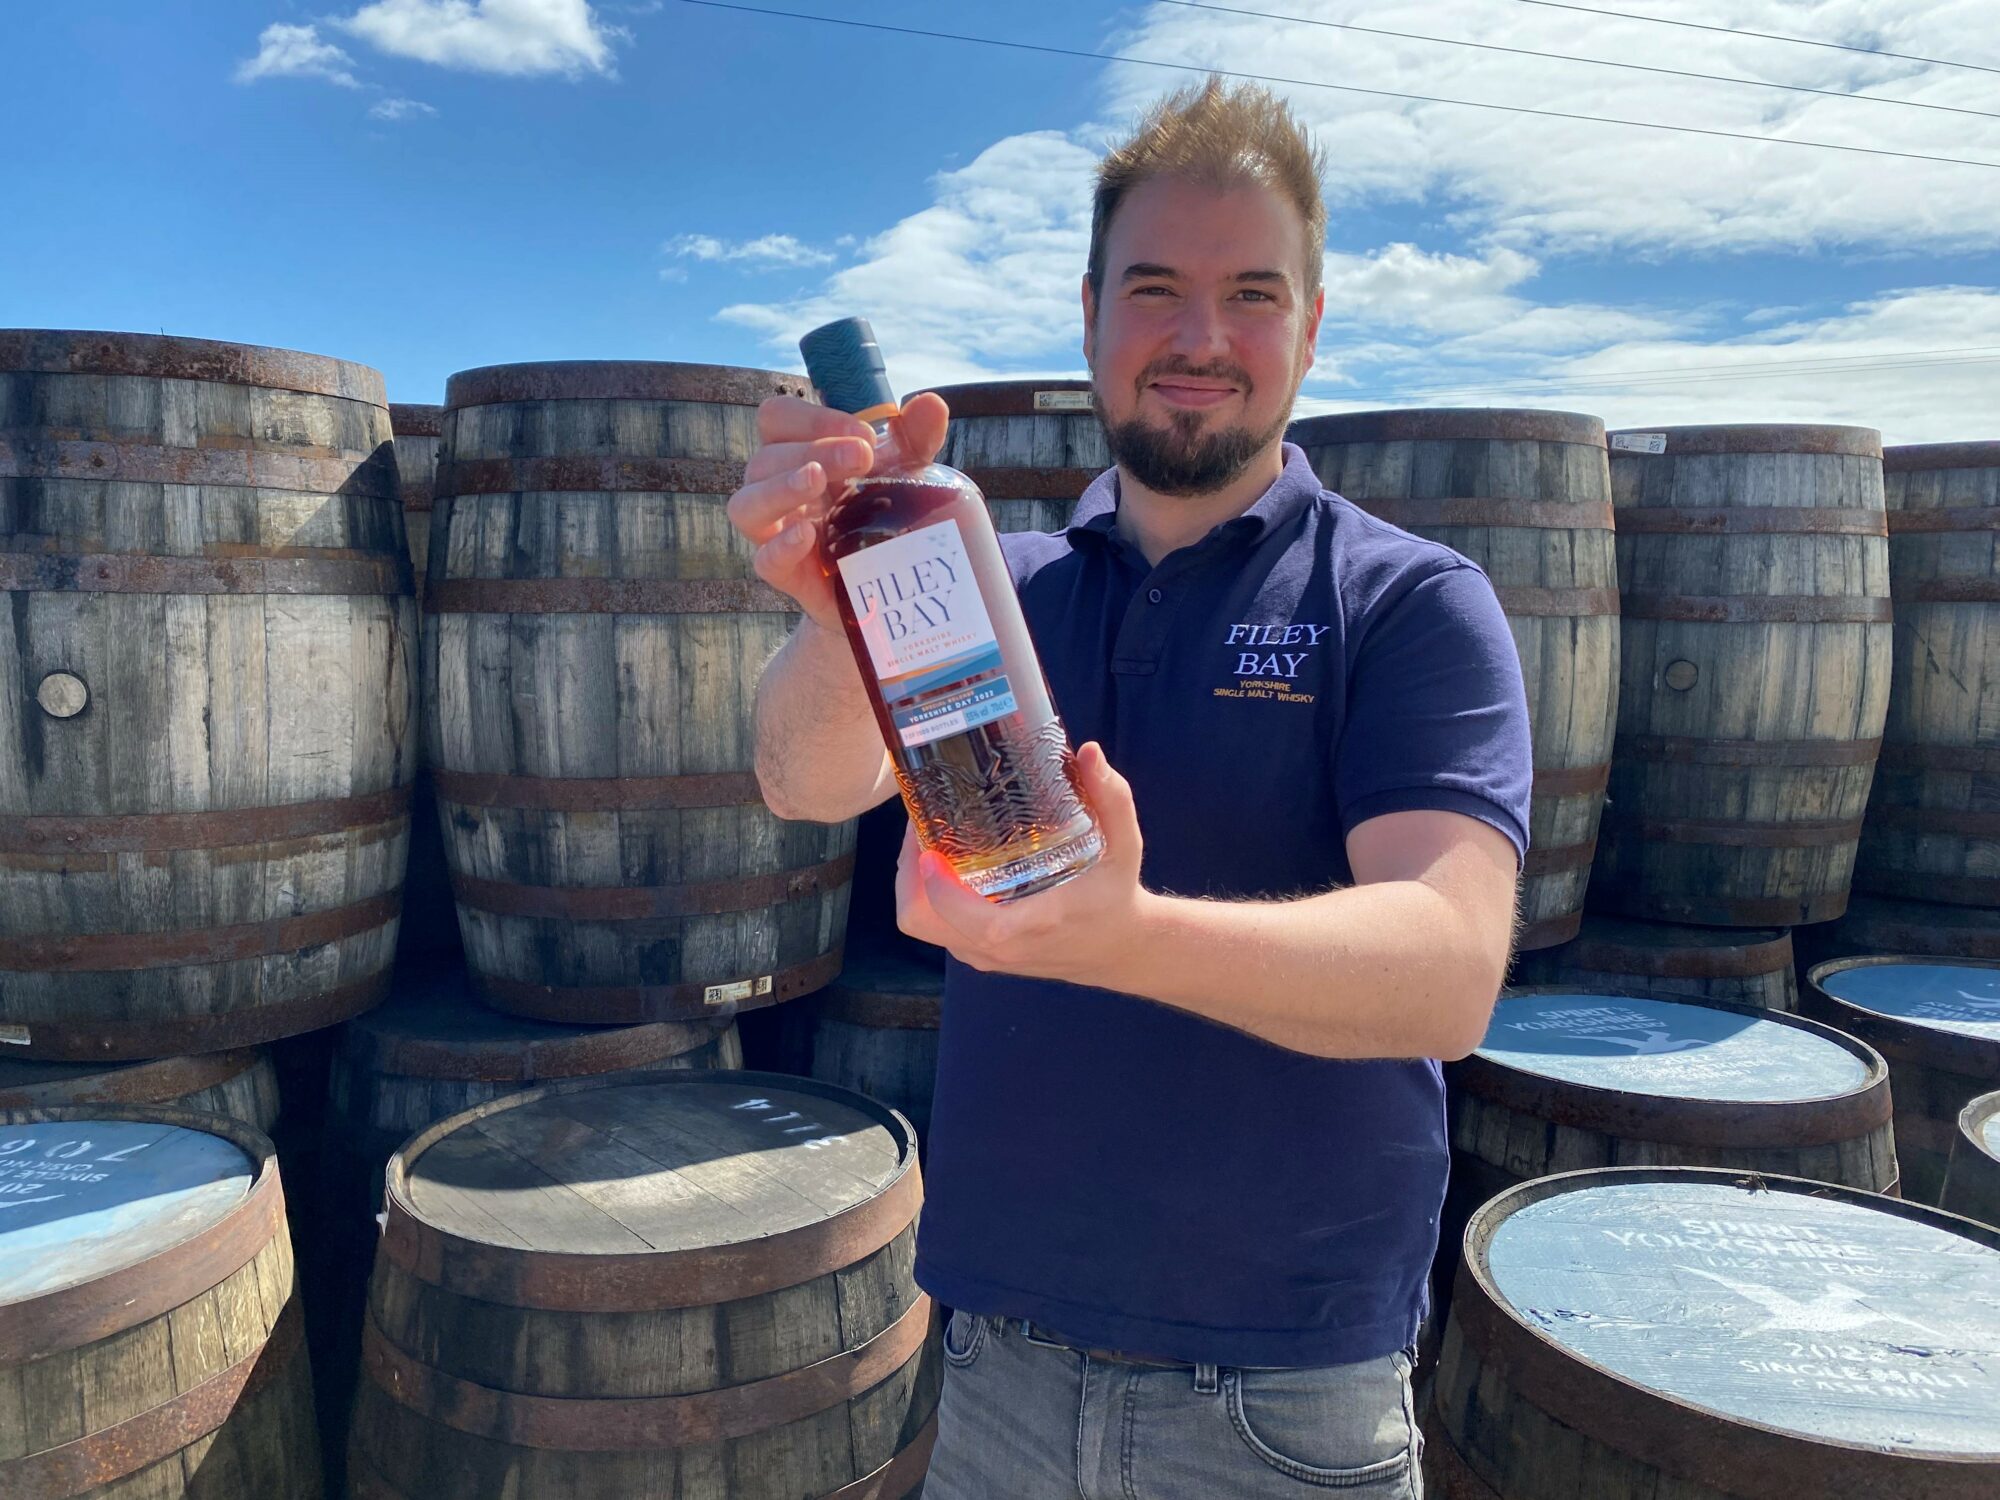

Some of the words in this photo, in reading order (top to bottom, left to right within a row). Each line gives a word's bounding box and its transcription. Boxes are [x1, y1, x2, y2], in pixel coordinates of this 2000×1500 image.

[857, 551, 958, 613] FILEY
[883, 589, 952, 641] BAY
[903, 631, 952, 651] YORKSHIRE
[917, 644, 940, 657] MALT
[943, 632, 977, 648] WHISKY
[1223, 624, 1331, 646] FILEY
[1233, 652, 1309, 678] BAY
[1213, 688, 1245, 698] SINGLE
[1247, 689, 1274, 699] MALT
[1277, 692, 1315, 703] WHISKY
[1239, 680, 1292, 692] YORKSHIRE
[909, 704, 953, 723] YORKSHIRE
[955, 697, 972, 709] DAY
[1503, 1013, 1657, 1031] YORKSHIRE
[1601, 1230, 1879, 1261] YORKSHIRE
[1739, 1360, 1870, 1381] SINGLE
